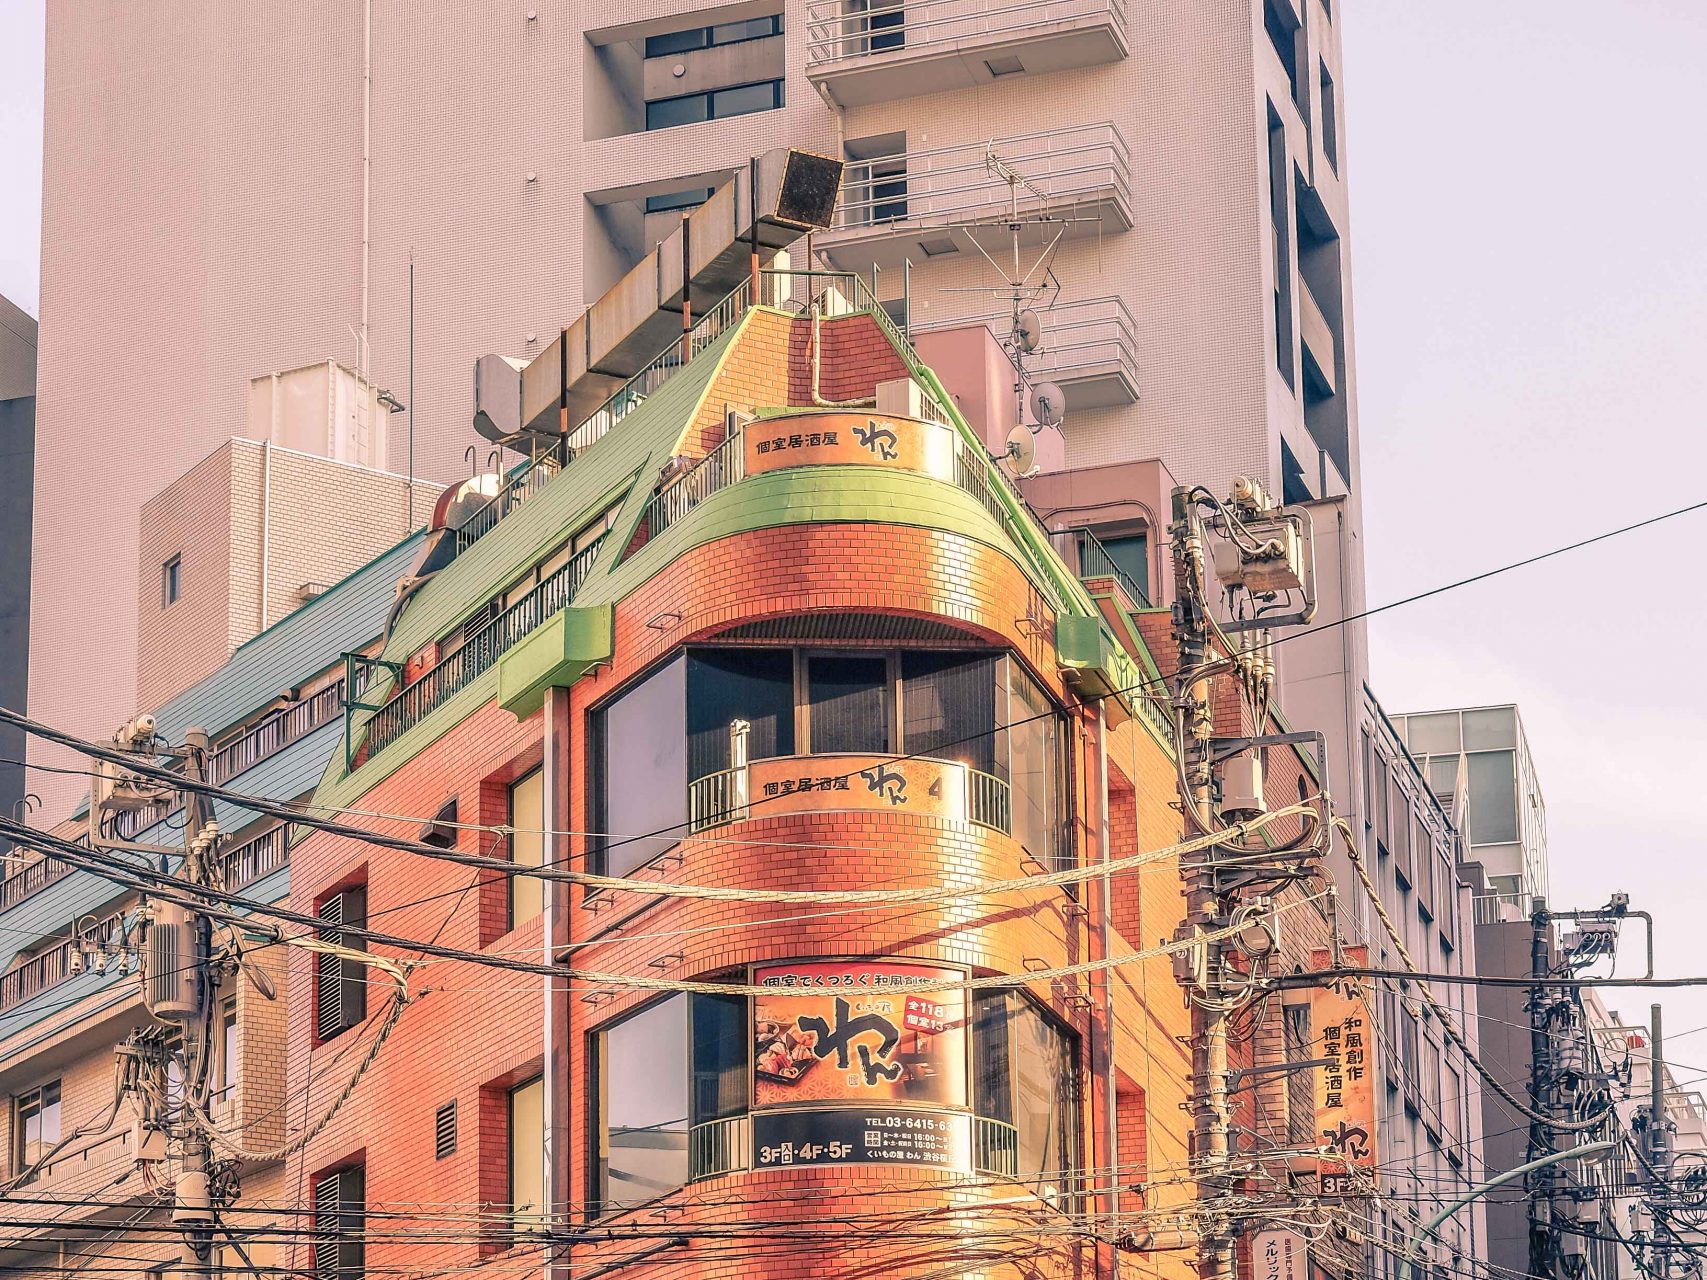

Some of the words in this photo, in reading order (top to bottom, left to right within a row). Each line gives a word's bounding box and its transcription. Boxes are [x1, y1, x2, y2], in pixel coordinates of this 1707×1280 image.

[756, 432, 839, 455] 個室居酒屋
[852, 420, 898, 460] わん
[763, 776, 850, 796] 個室居酒屋
[861, 765, 908, 805] わん
[797, 996, 902, 1085] わん
[1344, 1017, 1364, 1081] 和風創作
[1323, 1121, 1370, 1160] わん
